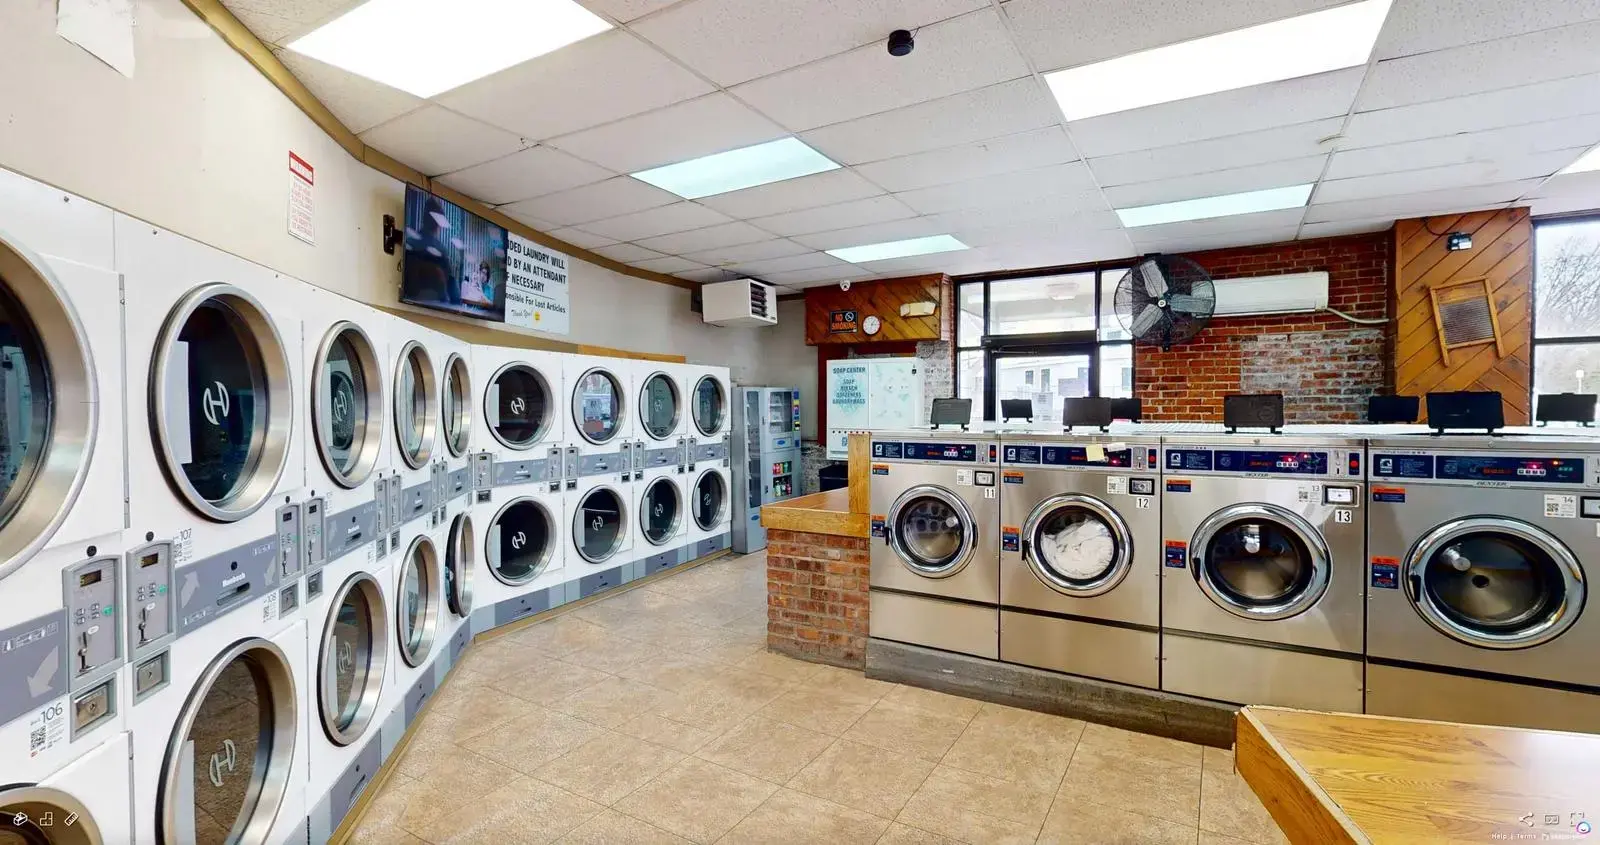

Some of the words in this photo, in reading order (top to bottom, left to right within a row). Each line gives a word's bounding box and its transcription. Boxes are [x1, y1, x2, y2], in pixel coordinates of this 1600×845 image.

[508, 241, 521, 253] DED
[523, 246, 549, 264] LAUNDRY
[551, 257, 565, 270] WILL
[514, 258, 521, 269] BY
[523, 262, 531, 274] AN
[533, 267, 567, 285] ATTENDANT
[511, 274, 544, 292] NECESSARY
[525, 295, 534, 304] For
[547, 302, 566, 313] Articles
[835, 313, 843, 321] NO
[831, 321, 857, 330] SMOKING
[847, 366, 866, 374] CENTER
[986, 488, 995, 497] 11
[1138, 498, 1149, 508] 12
[1337, 511, 1350, 522] 13
[180, 528, 192, 541] 107
[41, 702, 63, 723] 106
